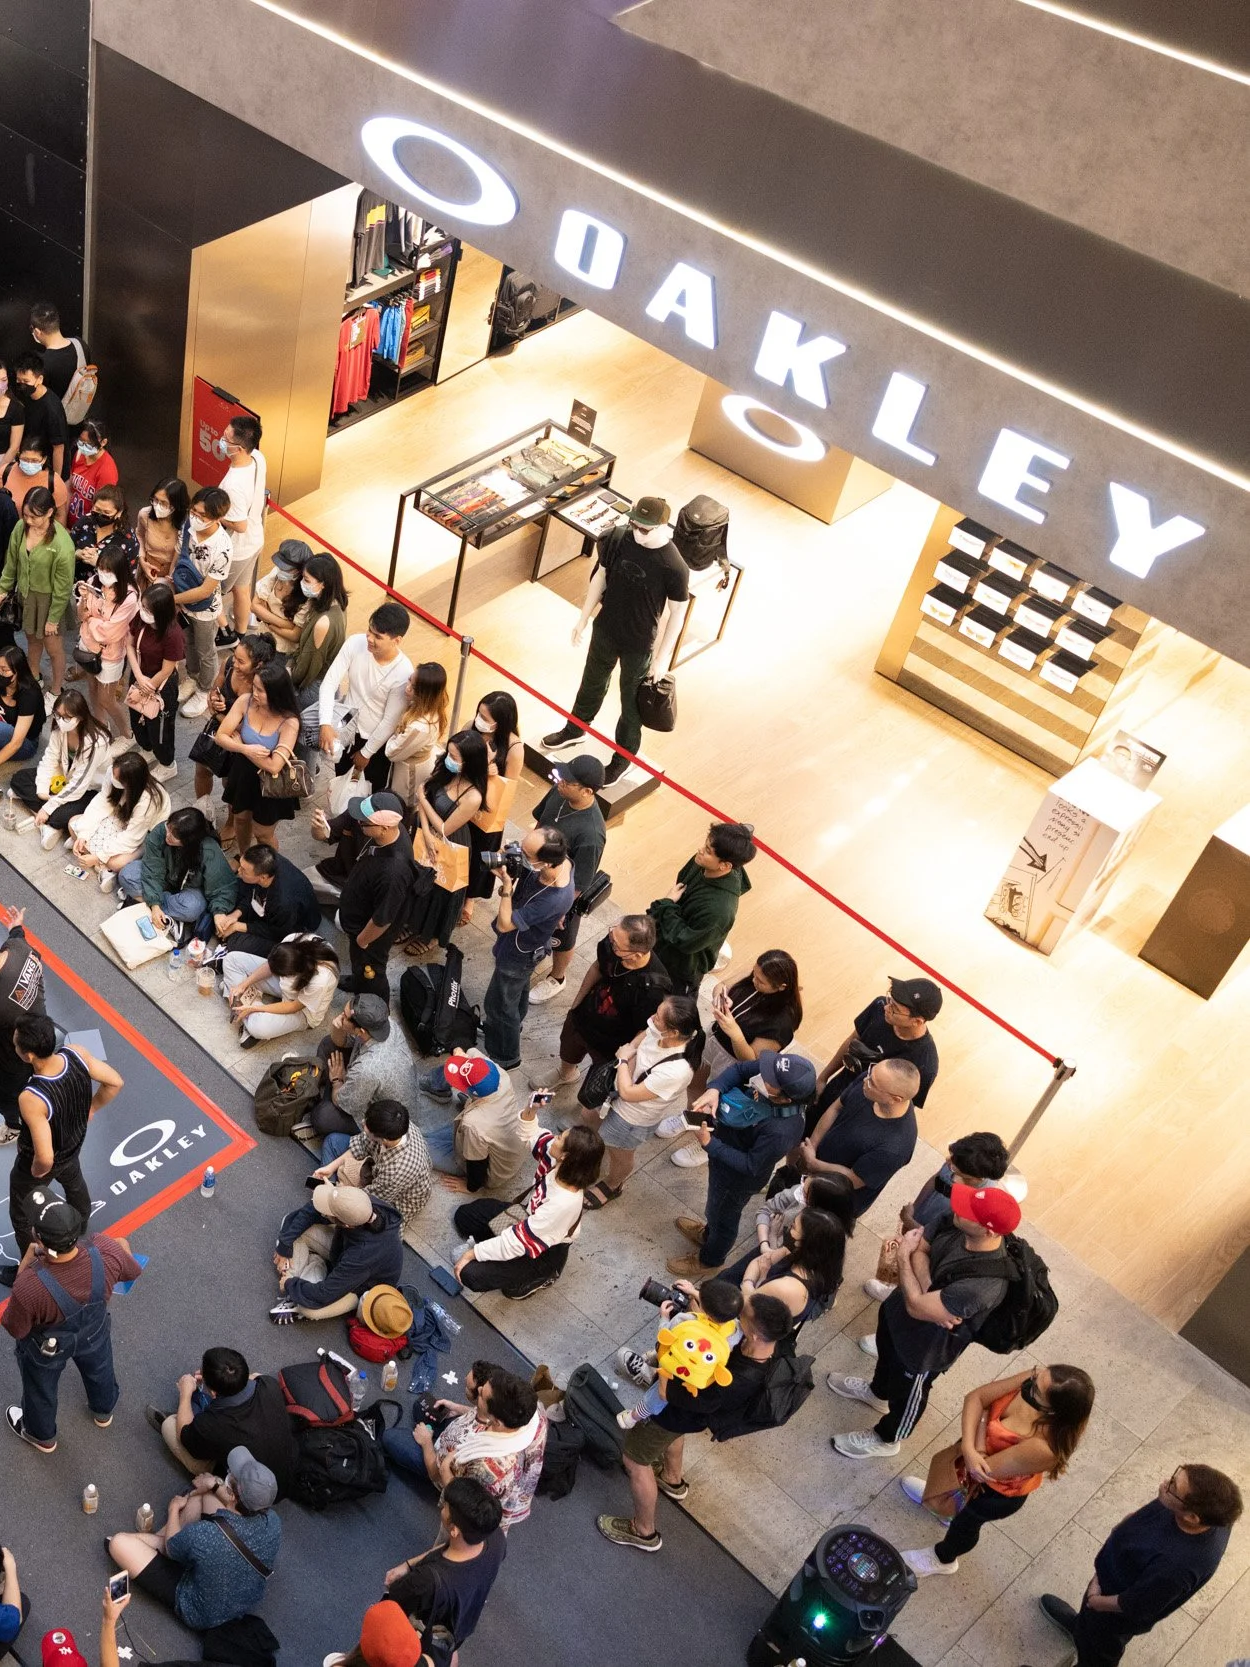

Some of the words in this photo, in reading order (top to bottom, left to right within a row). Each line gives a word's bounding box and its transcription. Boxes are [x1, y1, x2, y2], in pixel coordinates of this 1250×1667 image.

[554, 208, 1206, 580] OAKLEY
[200, 420, 210, 434] Up
[211, 427, 219, 437] to
[20, 959, 36, 985] VANS
[109, 1124, 207, 1196] OAKLEY
